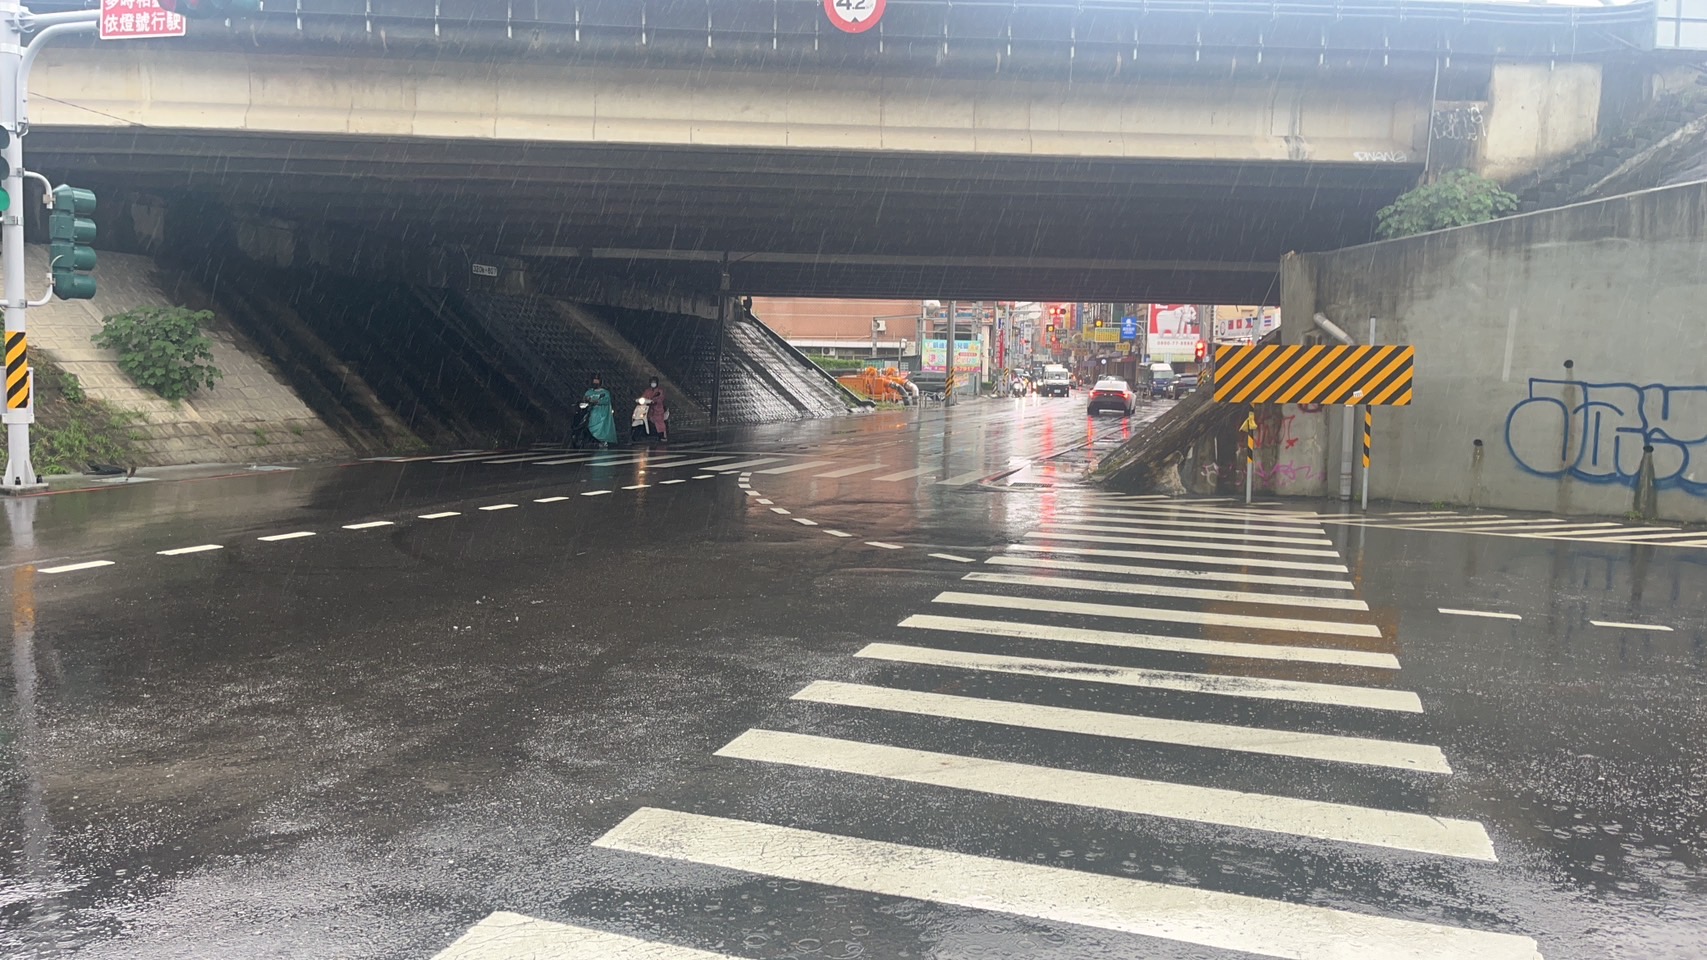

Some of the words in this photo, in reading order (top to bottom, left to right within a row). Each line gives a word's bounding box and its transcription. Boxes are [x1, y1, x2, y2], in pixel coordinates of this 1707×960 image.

[104, 12, 181, 33] 依燈號行駛
